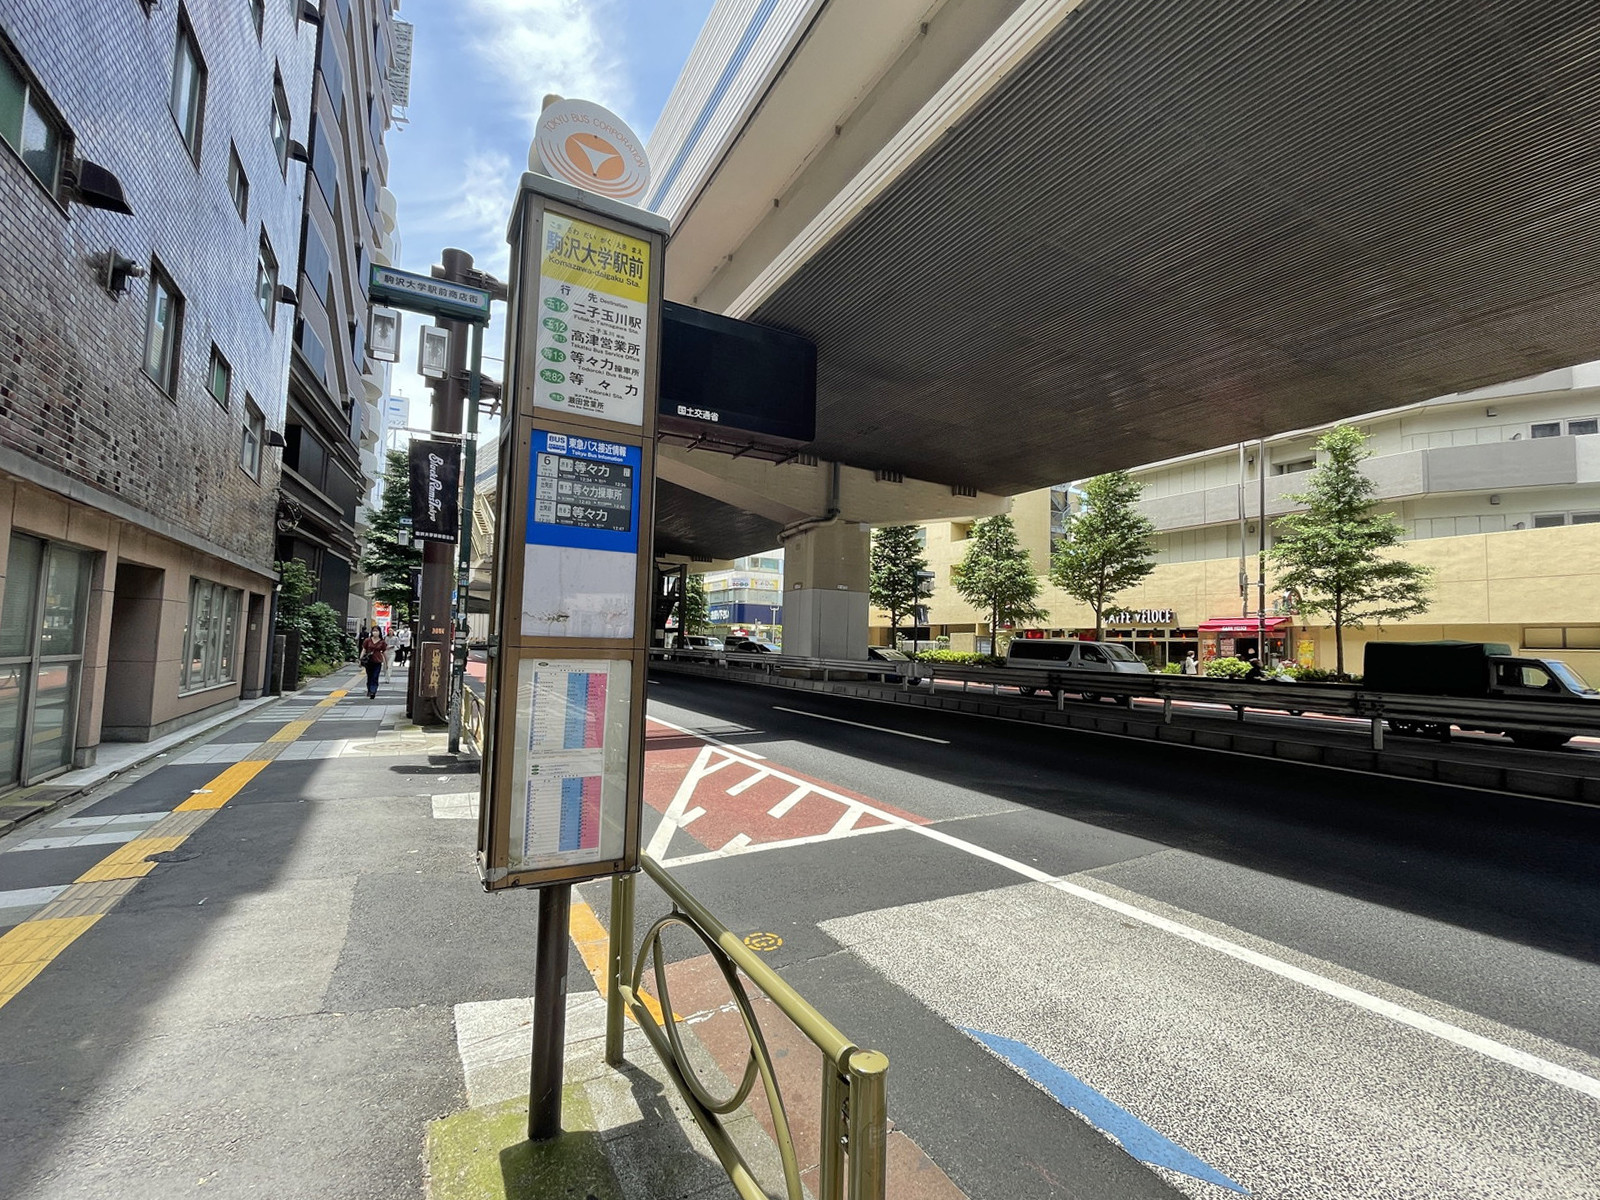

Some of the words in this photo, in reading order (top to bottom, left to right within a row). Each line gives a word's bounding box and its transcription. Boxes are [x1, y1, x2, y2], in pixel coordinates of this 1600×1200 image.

[543, 113, 569, 134] TOKYU
[571, 113, 590, 125] BUS
[593, 118, 646, 169] CORPORATION
[546, 230, 644, 280] 駒沢大学駅前
[549, 255, 624, 285] Komazawa-daigaku
[626, 277, 641, 288] Sta.
[384, 273, 479, 304] 駒沢大学駅前商店街
[572, 302, 642, 330] 二子玉川駅
[571, 329, 641, 357] 高津営業所
[569, 371, 639, 397] 等々力
[677, 405, 719, 422] 国土交通省
[548, 434, 566, 444] BUS
[568, 437, 627, 457] 東急バス接近情報
[428, 453, 444, 481] Black
[543, 455, 552, 466] 6
[574, 460, 610, 478] 等々力
[428, 478, 443, 504] Rams
[427, 499, 442, 522] Tokyo
[572, 506, 609, 522] 等々力
[1135, 609, 1171, 624] VELOCE
